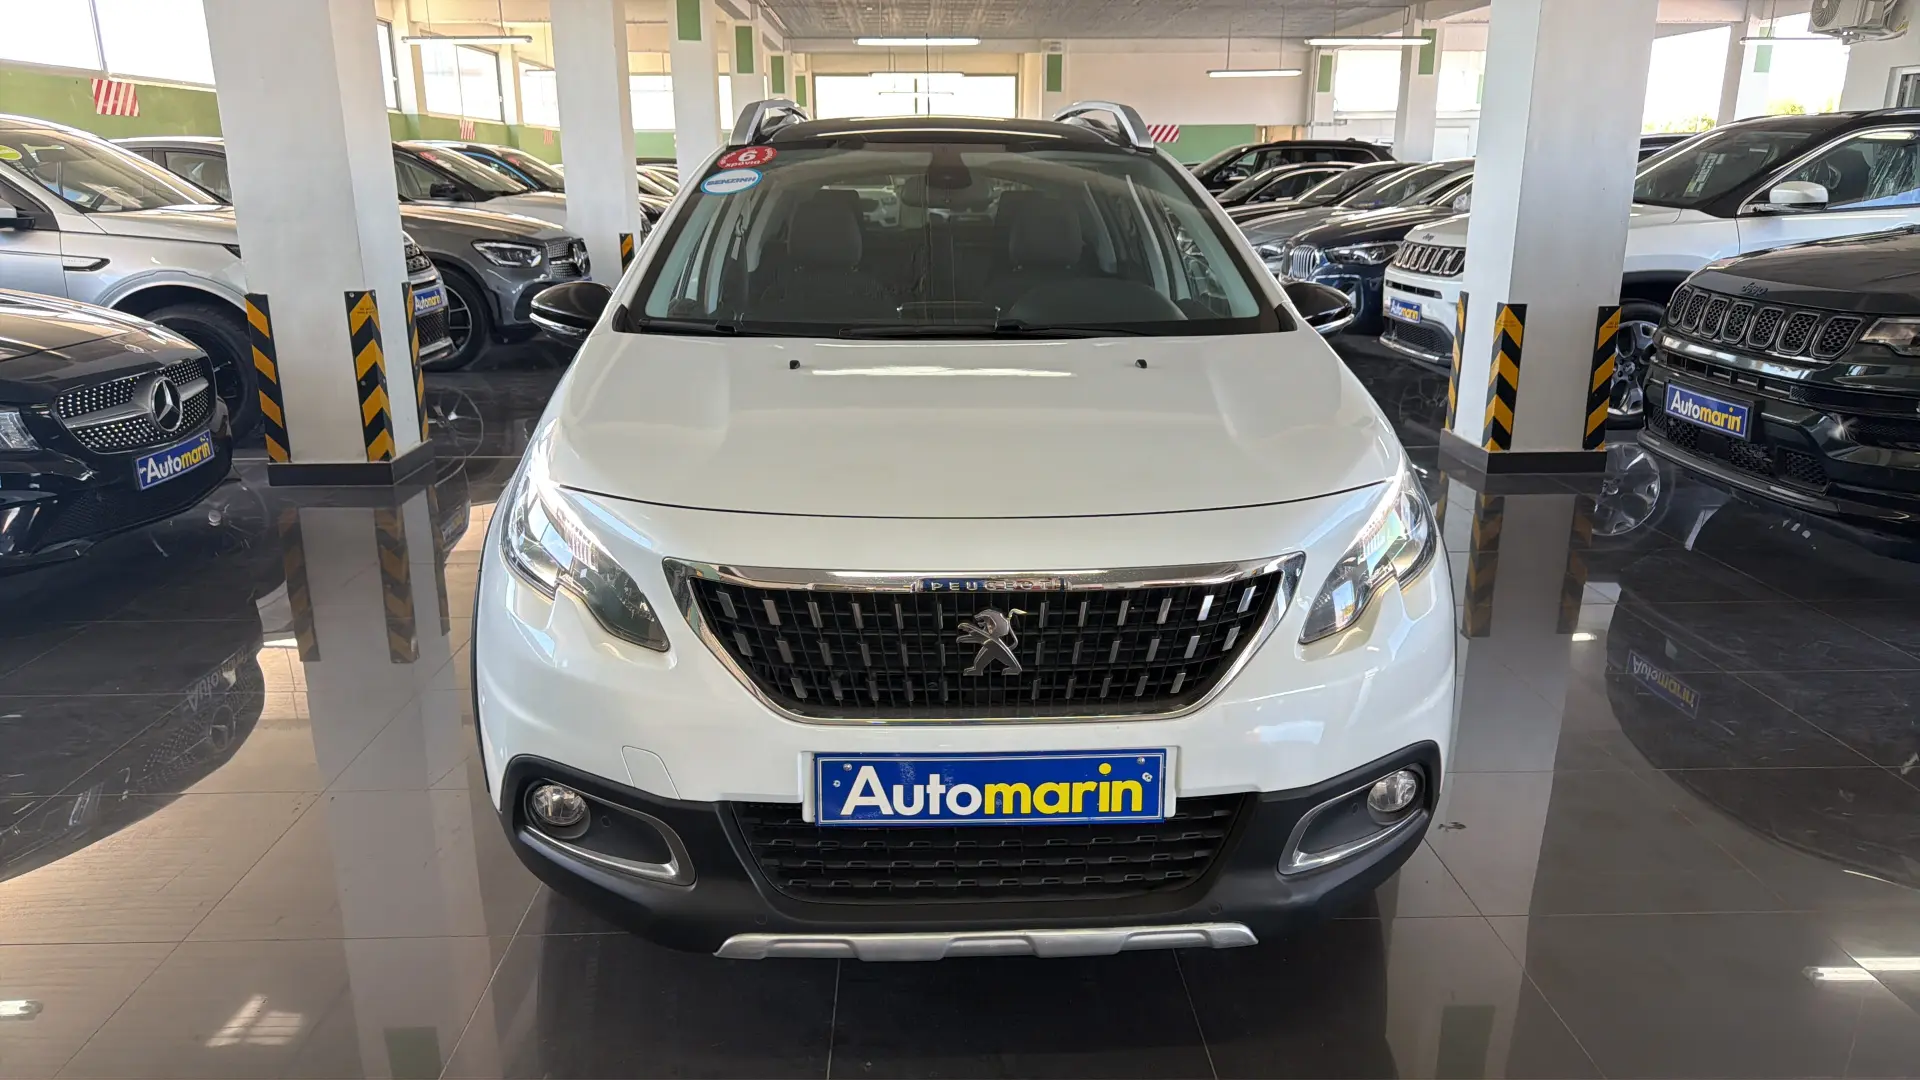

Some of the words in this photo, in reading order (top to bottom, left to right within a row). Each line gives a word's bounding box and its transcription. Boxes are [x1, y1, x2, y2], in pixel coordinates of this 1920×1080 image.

[738, 151, 757, 161] 6
[1742, 281, 1769, 297] Jeep
[1670, 390, 1742, 432] Automarin
[146, 438, 211, 484] Automarin
[931, 580, 1052, 592] PEUGEOT
[840, 762, 1143, 816] Automarin
